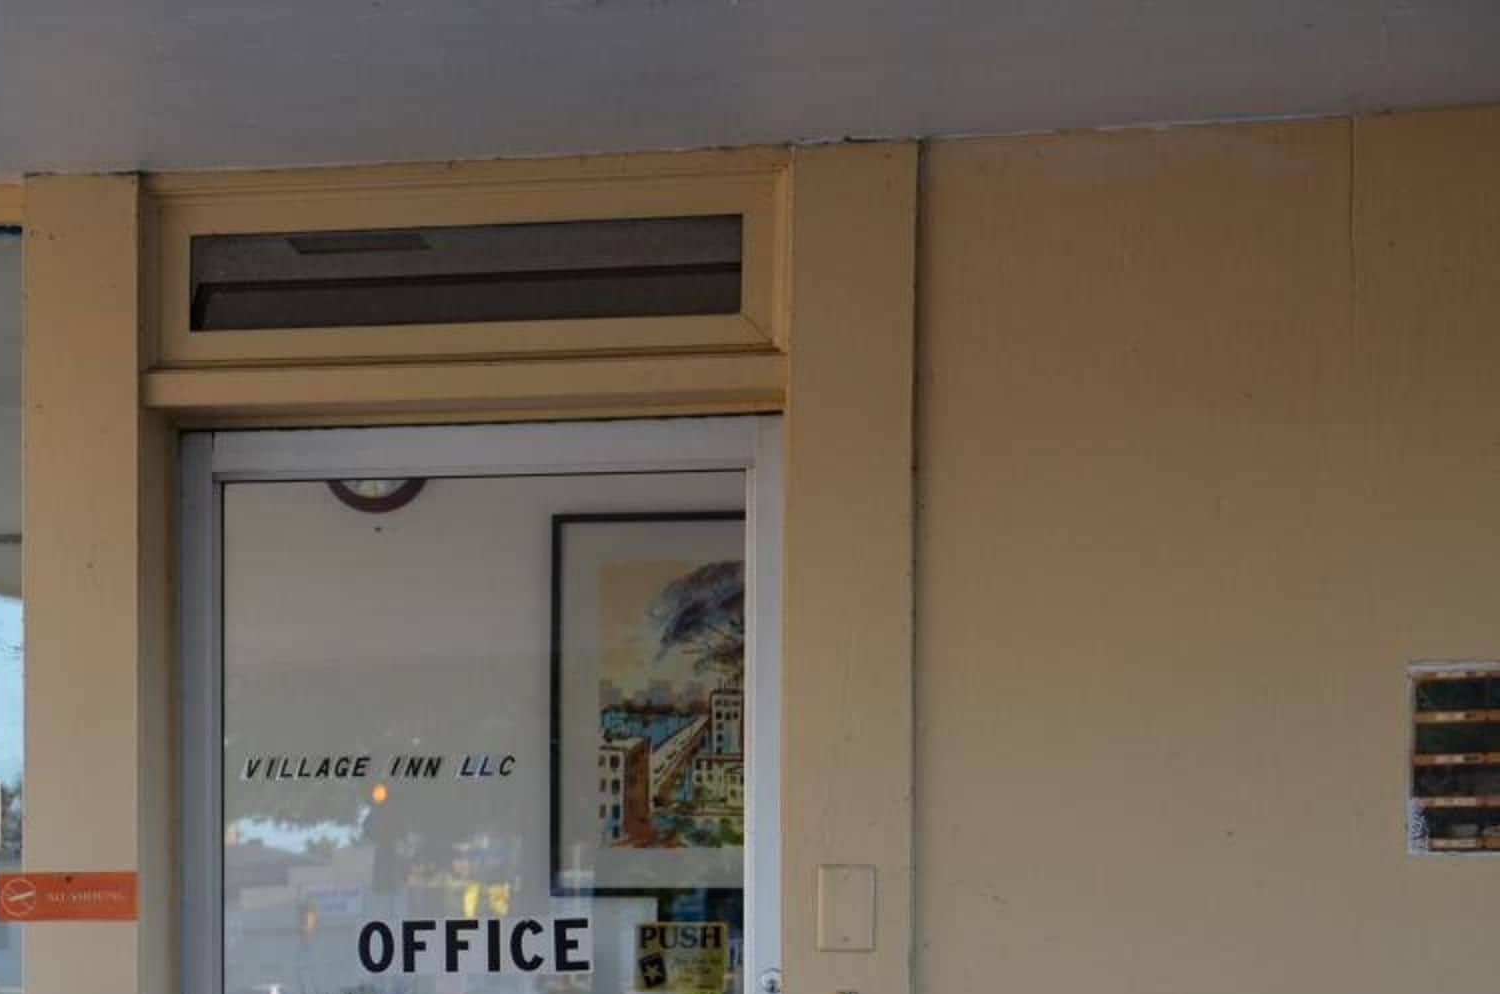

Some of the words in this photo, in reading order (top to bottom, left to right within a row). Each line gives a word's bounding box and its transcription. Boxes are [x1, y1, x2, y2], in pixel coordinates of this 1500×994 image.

[245, 756, 371, 777] VILLAGE
[390, 756, 442, 777] INN
[459, 756, 516, 777] LLC
[358, 919, 590, 973] OFFICE
[640, 925, 721, 949] PUSH
